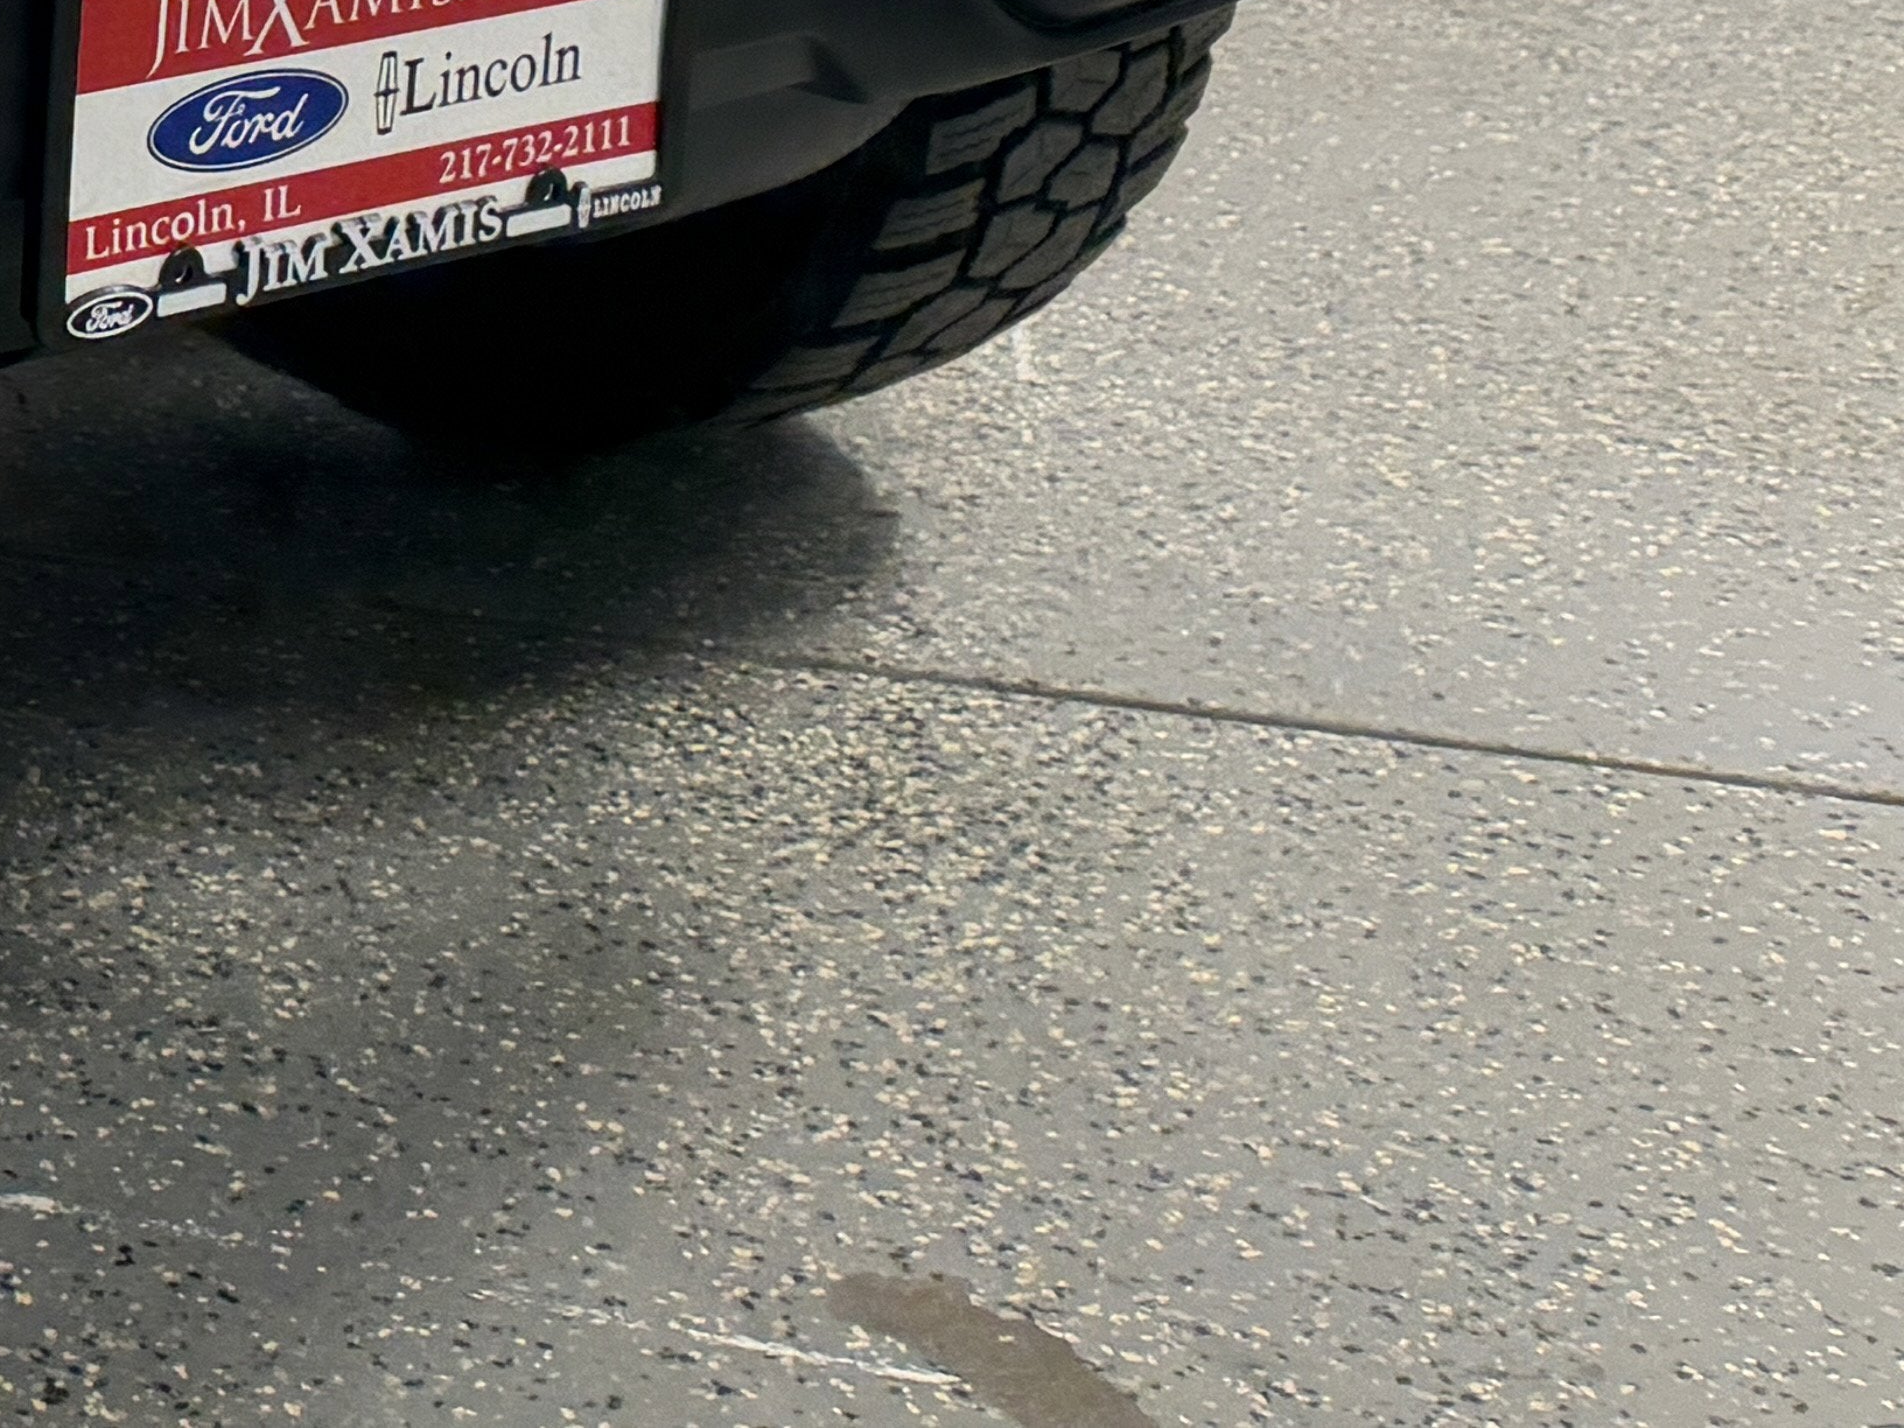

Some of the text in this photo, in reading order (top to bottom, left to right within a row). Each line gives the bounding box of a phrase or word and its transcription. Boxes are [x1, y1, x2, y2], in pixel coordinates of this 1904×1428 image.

[399, 32, 582, 117] Lincoln
[189, 85, 310, 156] Ford
[438, 115, 631, 185] 217-732-2111
[85, 184, 302, 261] Lincoln, IL
[593, 185, 662, 219] LINCOLN
[235, 198, 503, 306] JIM XAMIS
[85, 301, 135, 333] Ford
